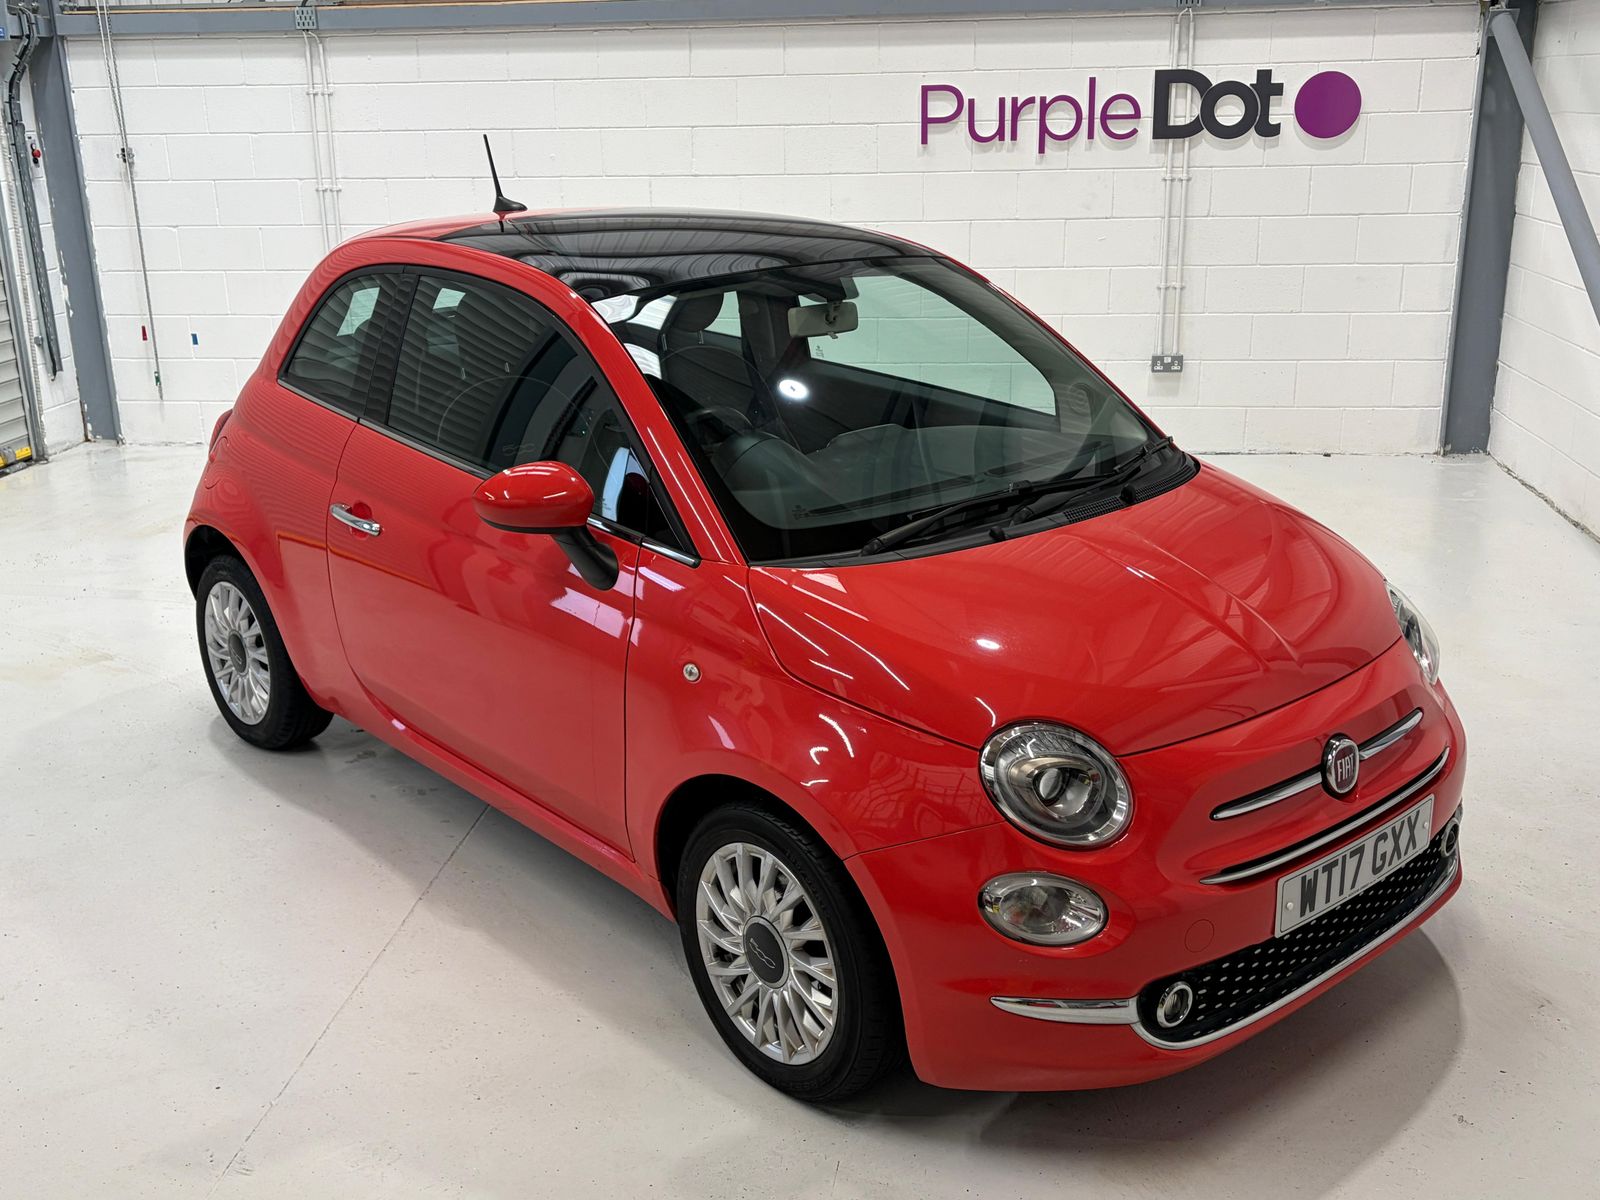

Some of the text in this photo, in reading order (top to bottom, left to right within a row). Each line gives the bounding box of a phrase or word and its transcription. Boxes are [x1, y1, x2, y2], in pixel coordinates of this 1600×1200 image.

[920, 69, 1284, 154] Purple Dot
[1337, 753, 1354, 782] FIAT
[1300, 809, 1420, 918] WT17 GXX
